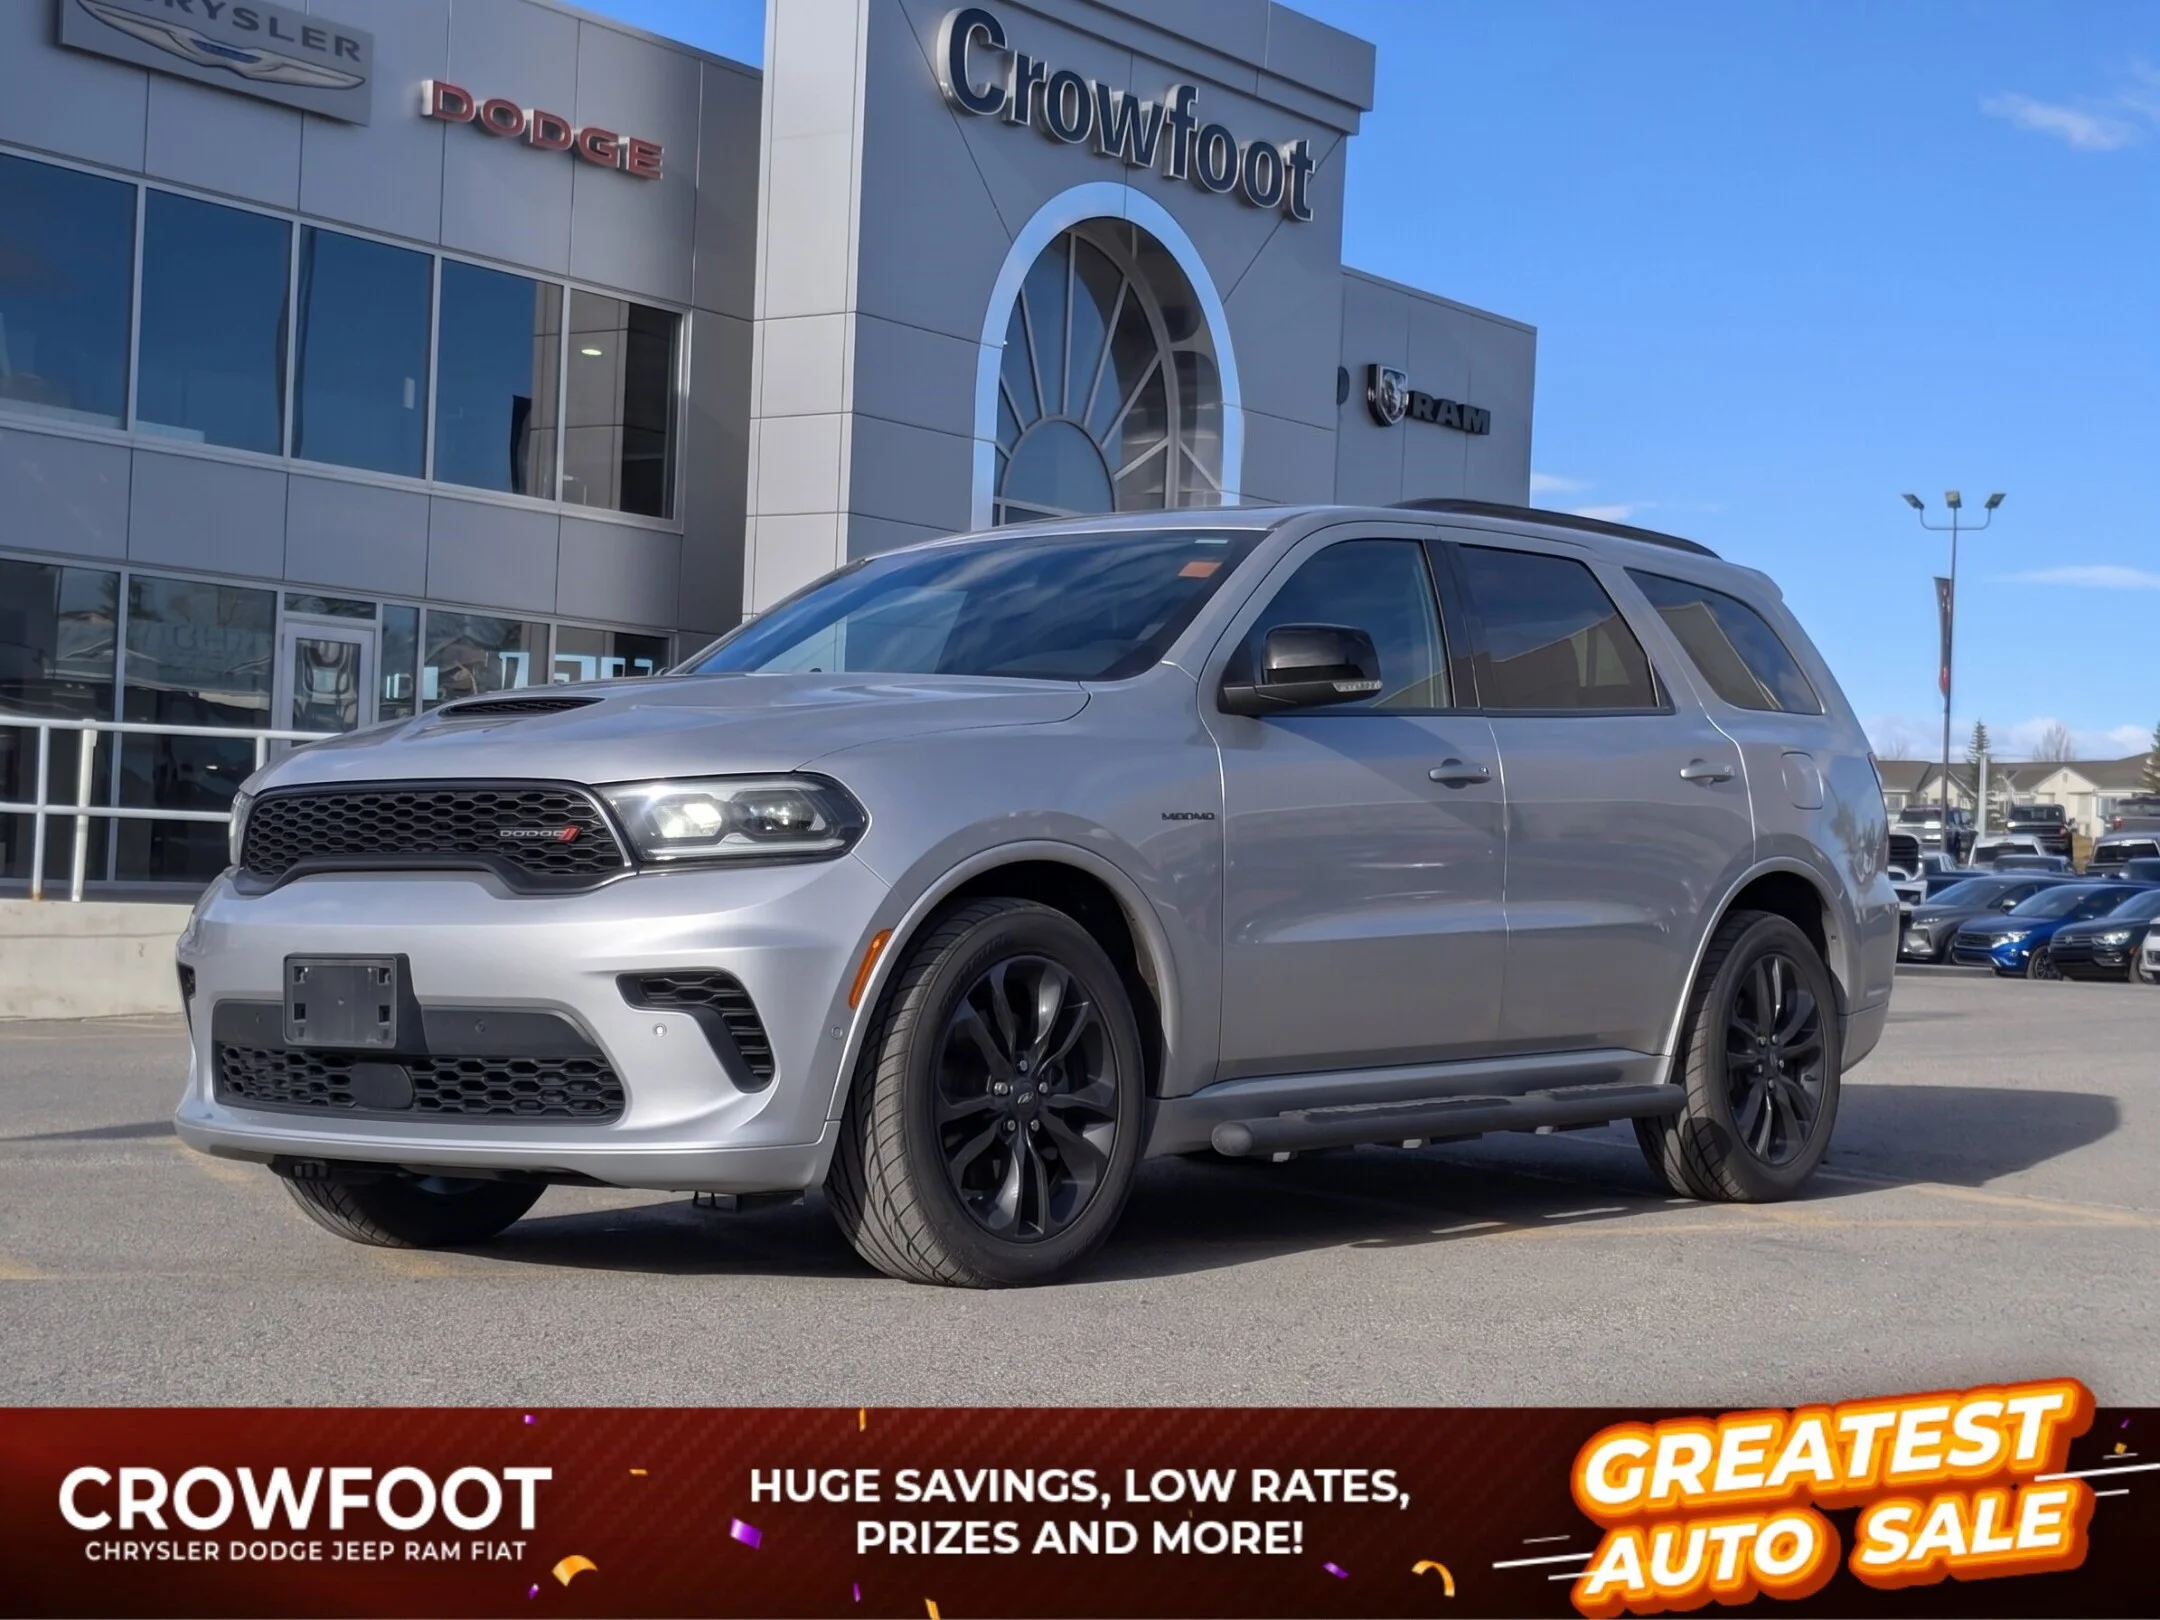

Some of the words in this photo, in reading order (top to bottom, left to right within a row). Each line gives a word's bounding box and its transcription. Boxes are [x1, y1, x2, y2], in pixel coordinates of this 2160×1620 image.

[421, 79, 664, 180] DODGE
[936, 7, 1315, 221] Crowfoot
[1405, 390, 1490, 436] RAM
